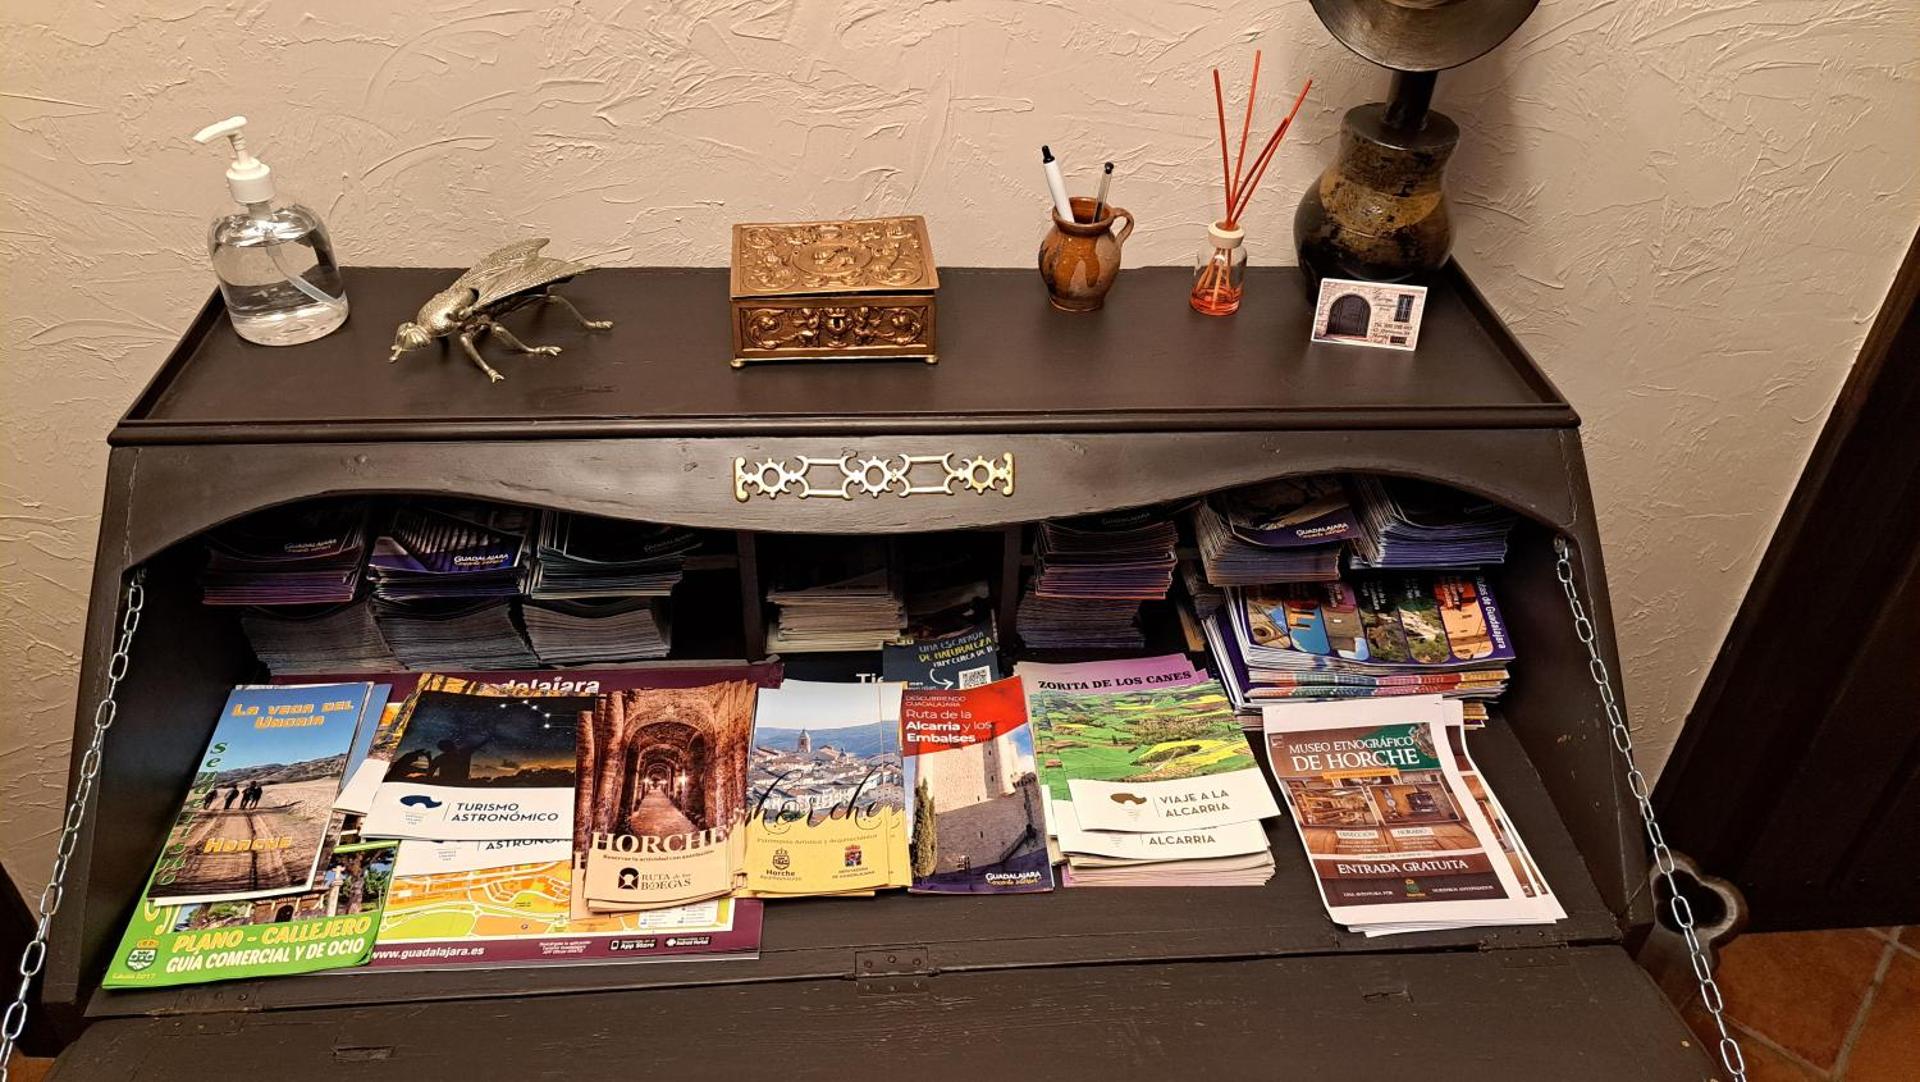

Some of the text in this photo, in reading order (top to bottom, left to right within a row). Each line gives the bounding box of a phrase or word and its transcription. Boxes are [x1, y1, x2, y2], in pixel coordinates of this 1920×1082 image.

[1486, 606, 1506, 649] Guadalajara
[1038, 671, 1193, 690] ZORITA DE LOS CANES
[906, 709, 972, 719] Ruta de la
[906, 721, 992, 733] Alcarria y los
[907, 733, 976, 743] Embalses
[1289, 741, 1331, 755] MUSEO
[1333, 735, 1414, 751] ETNOGRÁFICO
[1292, 748, 1420, 772] DE HORCHE
[1160, 789, 1230, 804] VIAJE A LA
[456, 802, 519, 812] TURISMO
[1165, 803, 1230, 818] ALCARRIA
[451, 811, 559, 822] ASTRONÓMICO
[591, 826, 727, 853] HORCHE
[1149, 835, 1216, 845] ALCARRIA
[1337, 860, 1469, 874] ENTRADA GRATUITA
[985, 871, 1041, 880] GUADALAJARA
[173, 929, 244, 953] PLANO
[261, 916, 371, 945] CALLEJERO
[166, 938, 365, 973] GUÍA COMERCIAL Y DE OCIO
